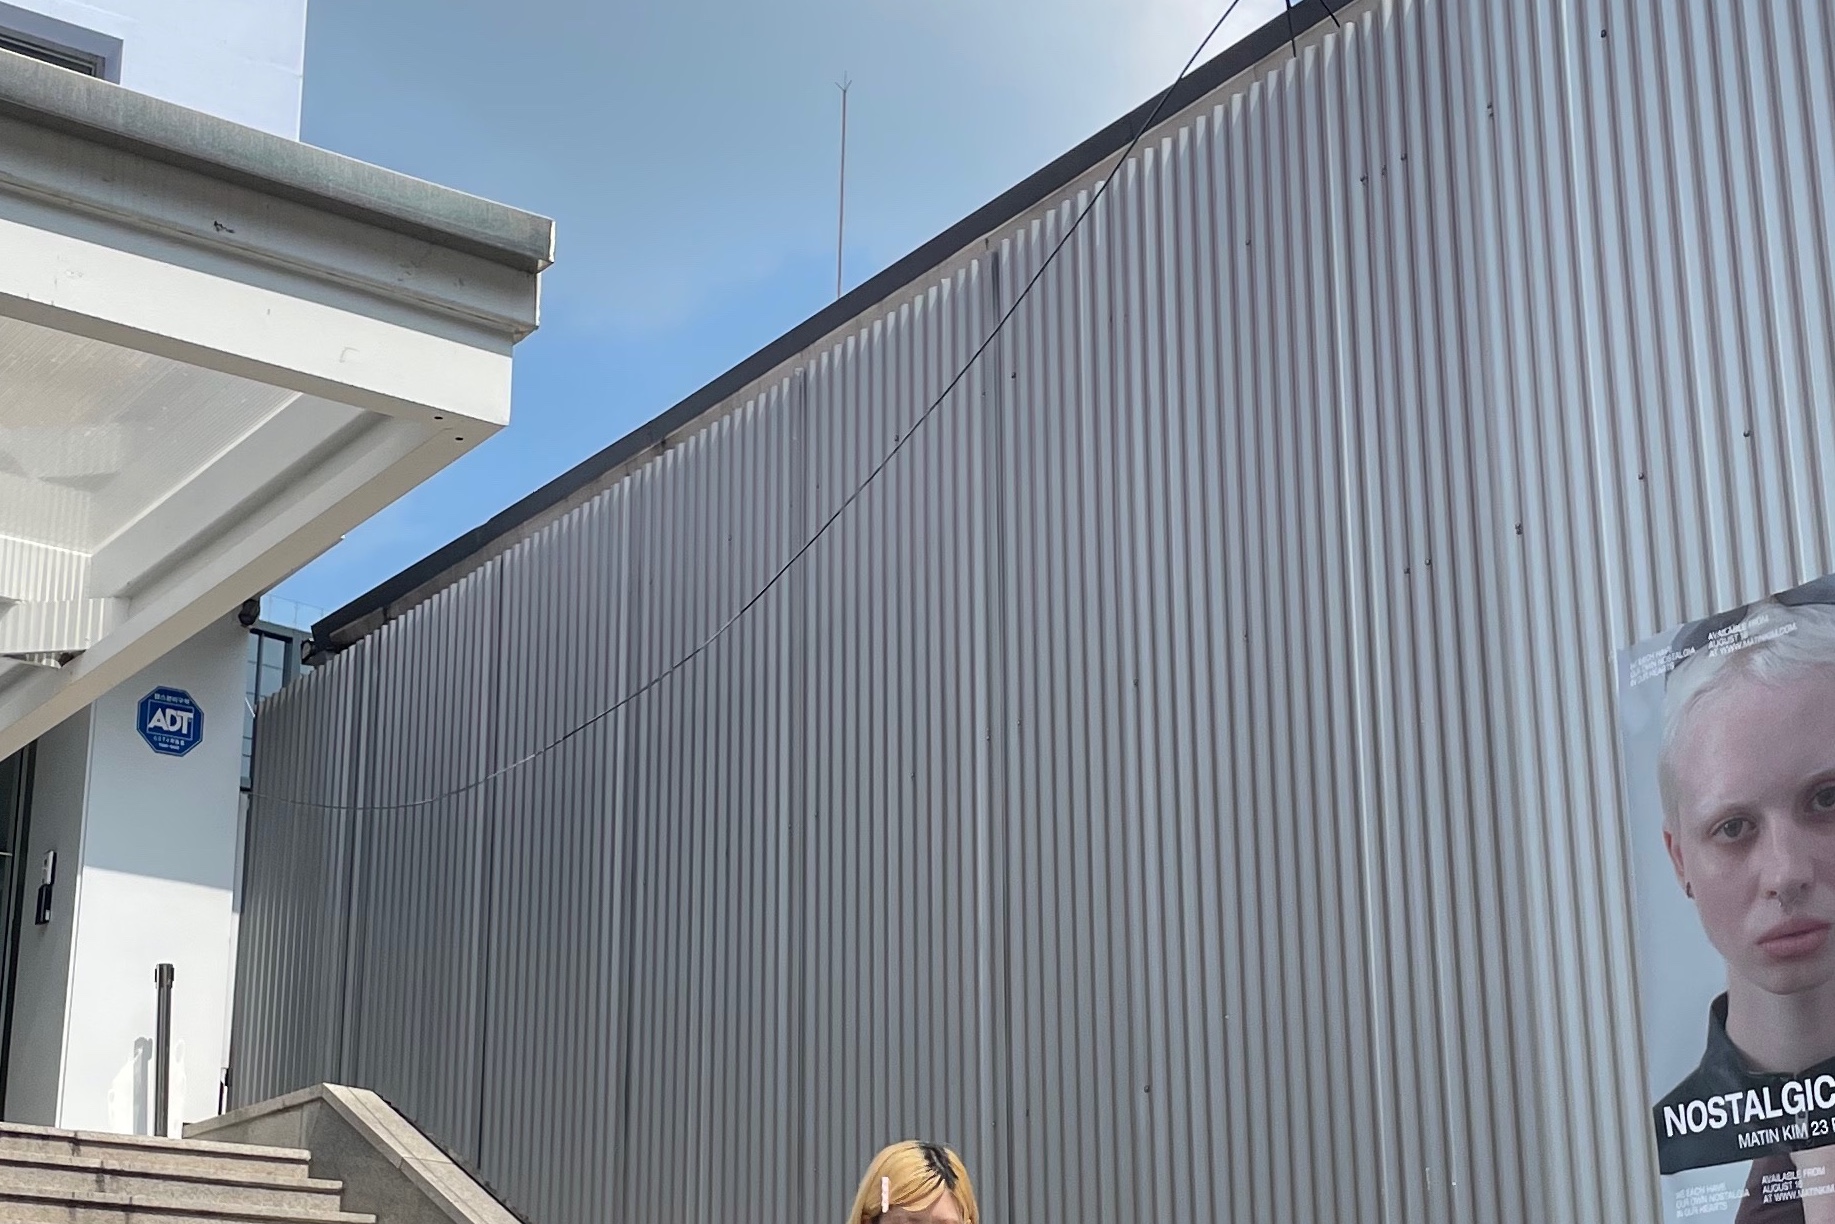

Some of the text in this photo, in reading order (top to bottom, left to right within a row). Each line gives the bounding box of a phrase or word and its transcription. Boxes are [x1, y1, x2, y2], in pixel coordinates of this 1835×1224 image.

[147, 707, 194, 734] ADT
[1663, 1074, 1835, 1138] NOSTALGIC
[1737, 1127, 1780, 1149] MATIN
[1782, 1122, 1809, 1142] KIM
[1810, 1118, 1829, 1137] 23
[1762, 1165, 1826, 1184] AVAILABLE FROM
[1763, 1180, 1793, 1194] AUGUST
[1763, 1194, 1773, 1204] AT
